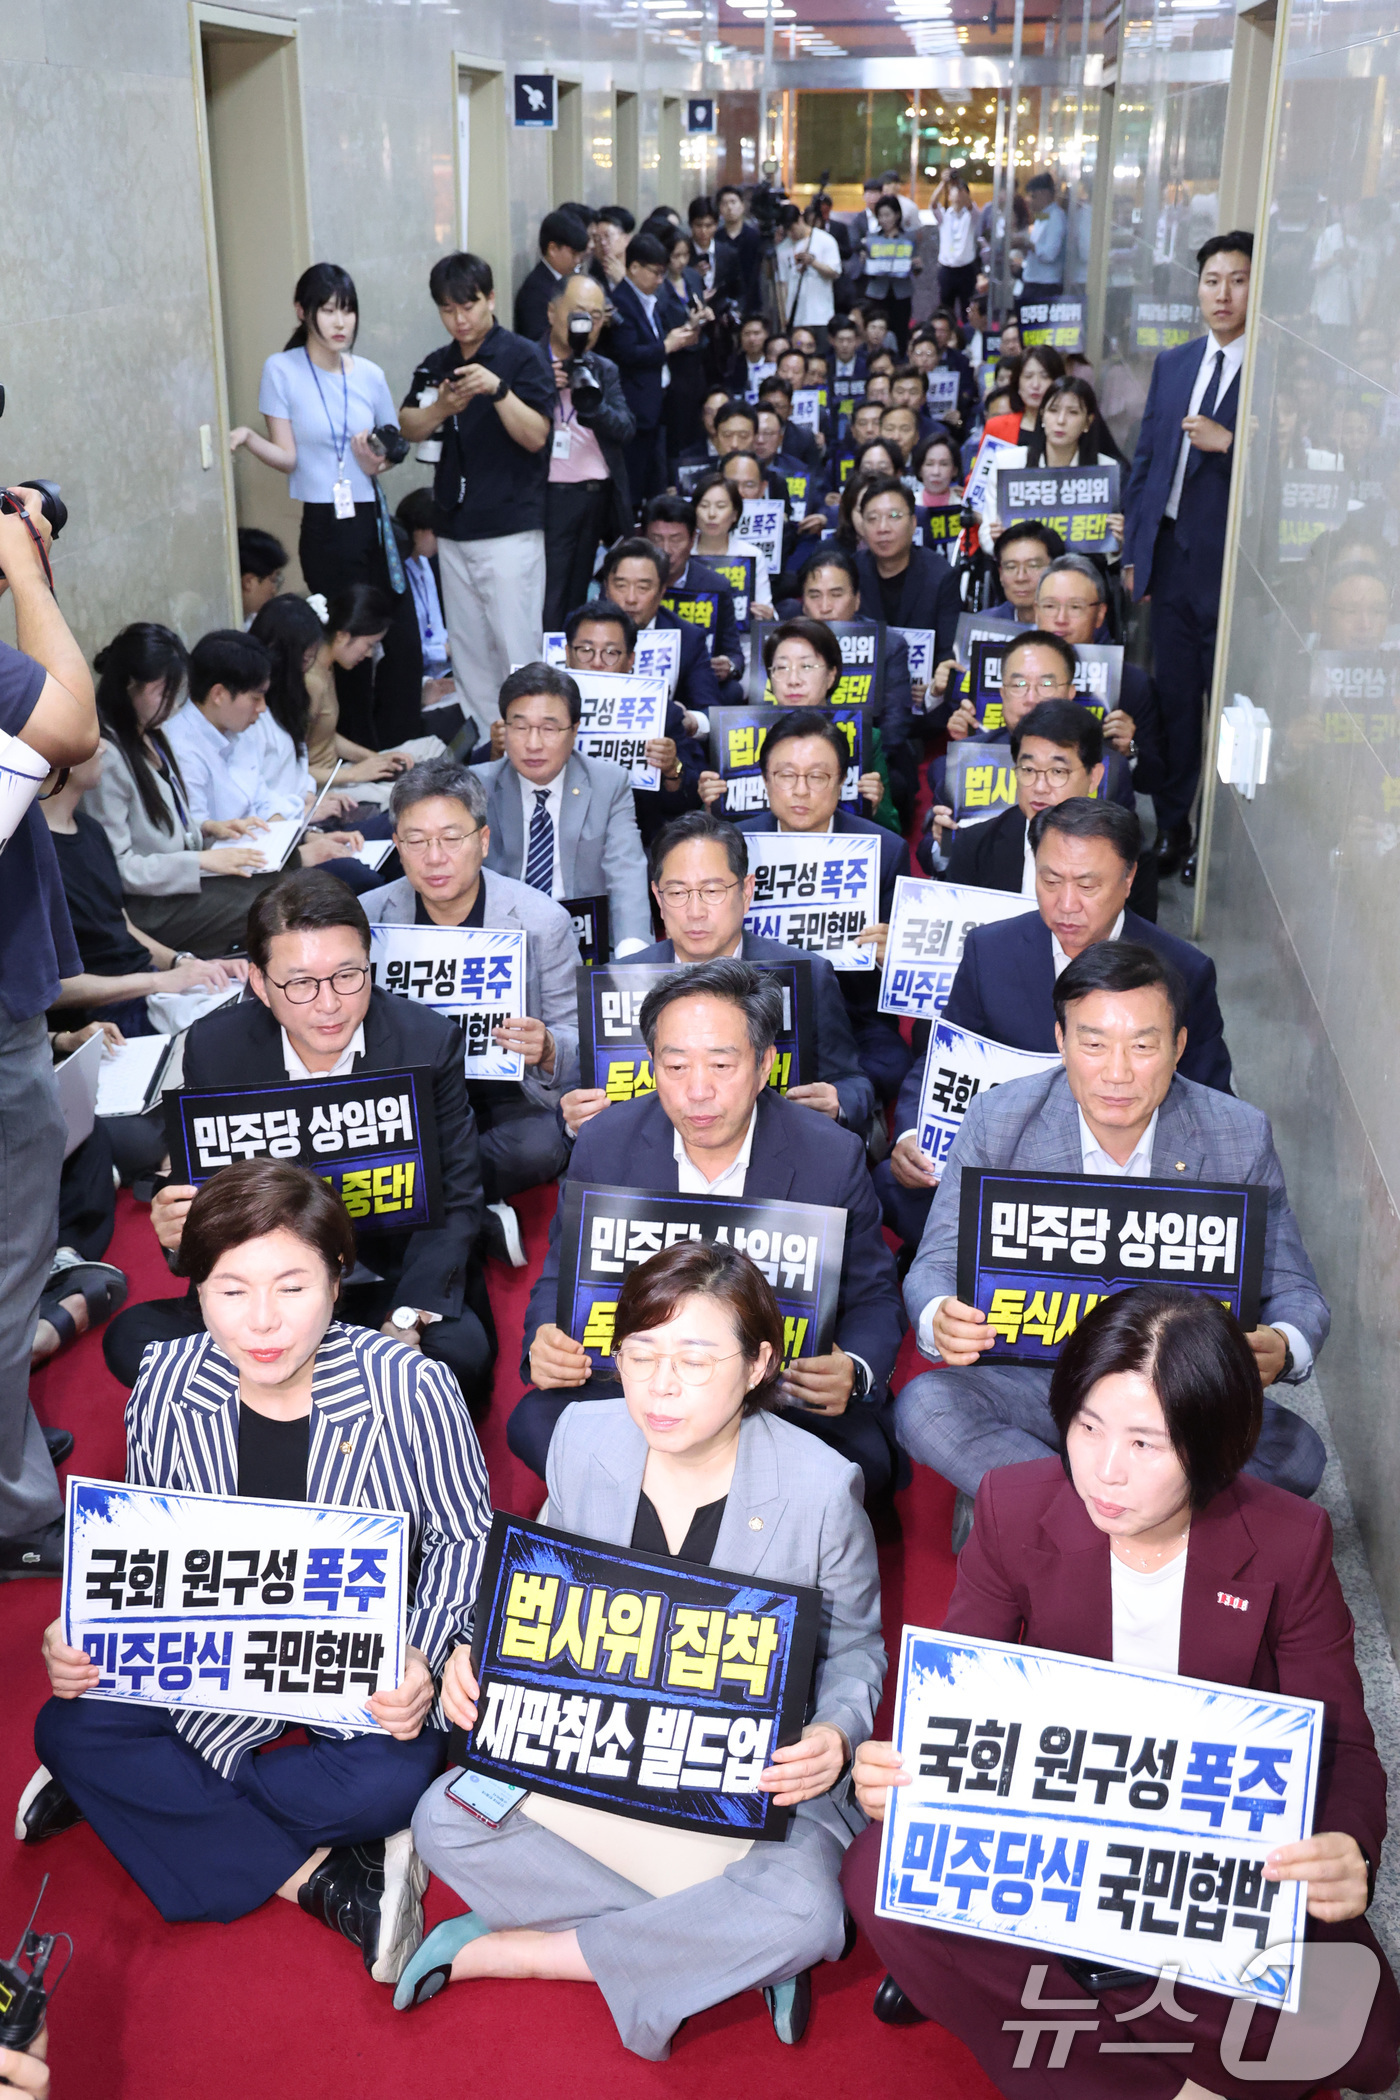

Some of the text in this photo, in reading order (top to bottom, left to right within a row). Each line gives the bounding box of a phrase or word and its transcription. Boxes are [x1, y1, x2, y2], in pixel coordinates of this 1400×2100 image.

[1008, 480, 1058, 507] 민주당
[1060, 478, 1109, 505] 상임위
[752, 513, 777, 535] 폭주
[1070, 513, 1108, 542] 중단!
[639, 647, 673, 677] 폭주
[839, 636, 875, 664] 임위
[1075, 661, 1109, 693] 임위
[580, 696, 657, 730] 구성 폭주
[965, 765, 1017, 807] 법사
[754, 858, 869, 902] 원구성 폭주
[787, 910, 867, 951] 국민협박
[902, 918, 953, 957] 국회
[386, 955, 513, 1000] 원구성 폭주
[932, 1067, 980, 1114] 국회
[193, 1094, 413, 1168] 민주당 상임위
[340, 1161, 416, 1218] 중단!
[990, 1201, 1239, 1274] 민주당 상임위
[85, 1548, 389, 1612] 국회 원구성 폭주
[501, 1572, 779, 1697] 법사위 집착
[82, 1630, 385, 1697] 민주당식 국민협박
[475, 1681, 774, 1795] 재판취소 빌드업
[919, 1716, 1293, 1833] 국회 원구성 폭주
[900, 1821, 1281, 1950] 민주당식 국민협박
